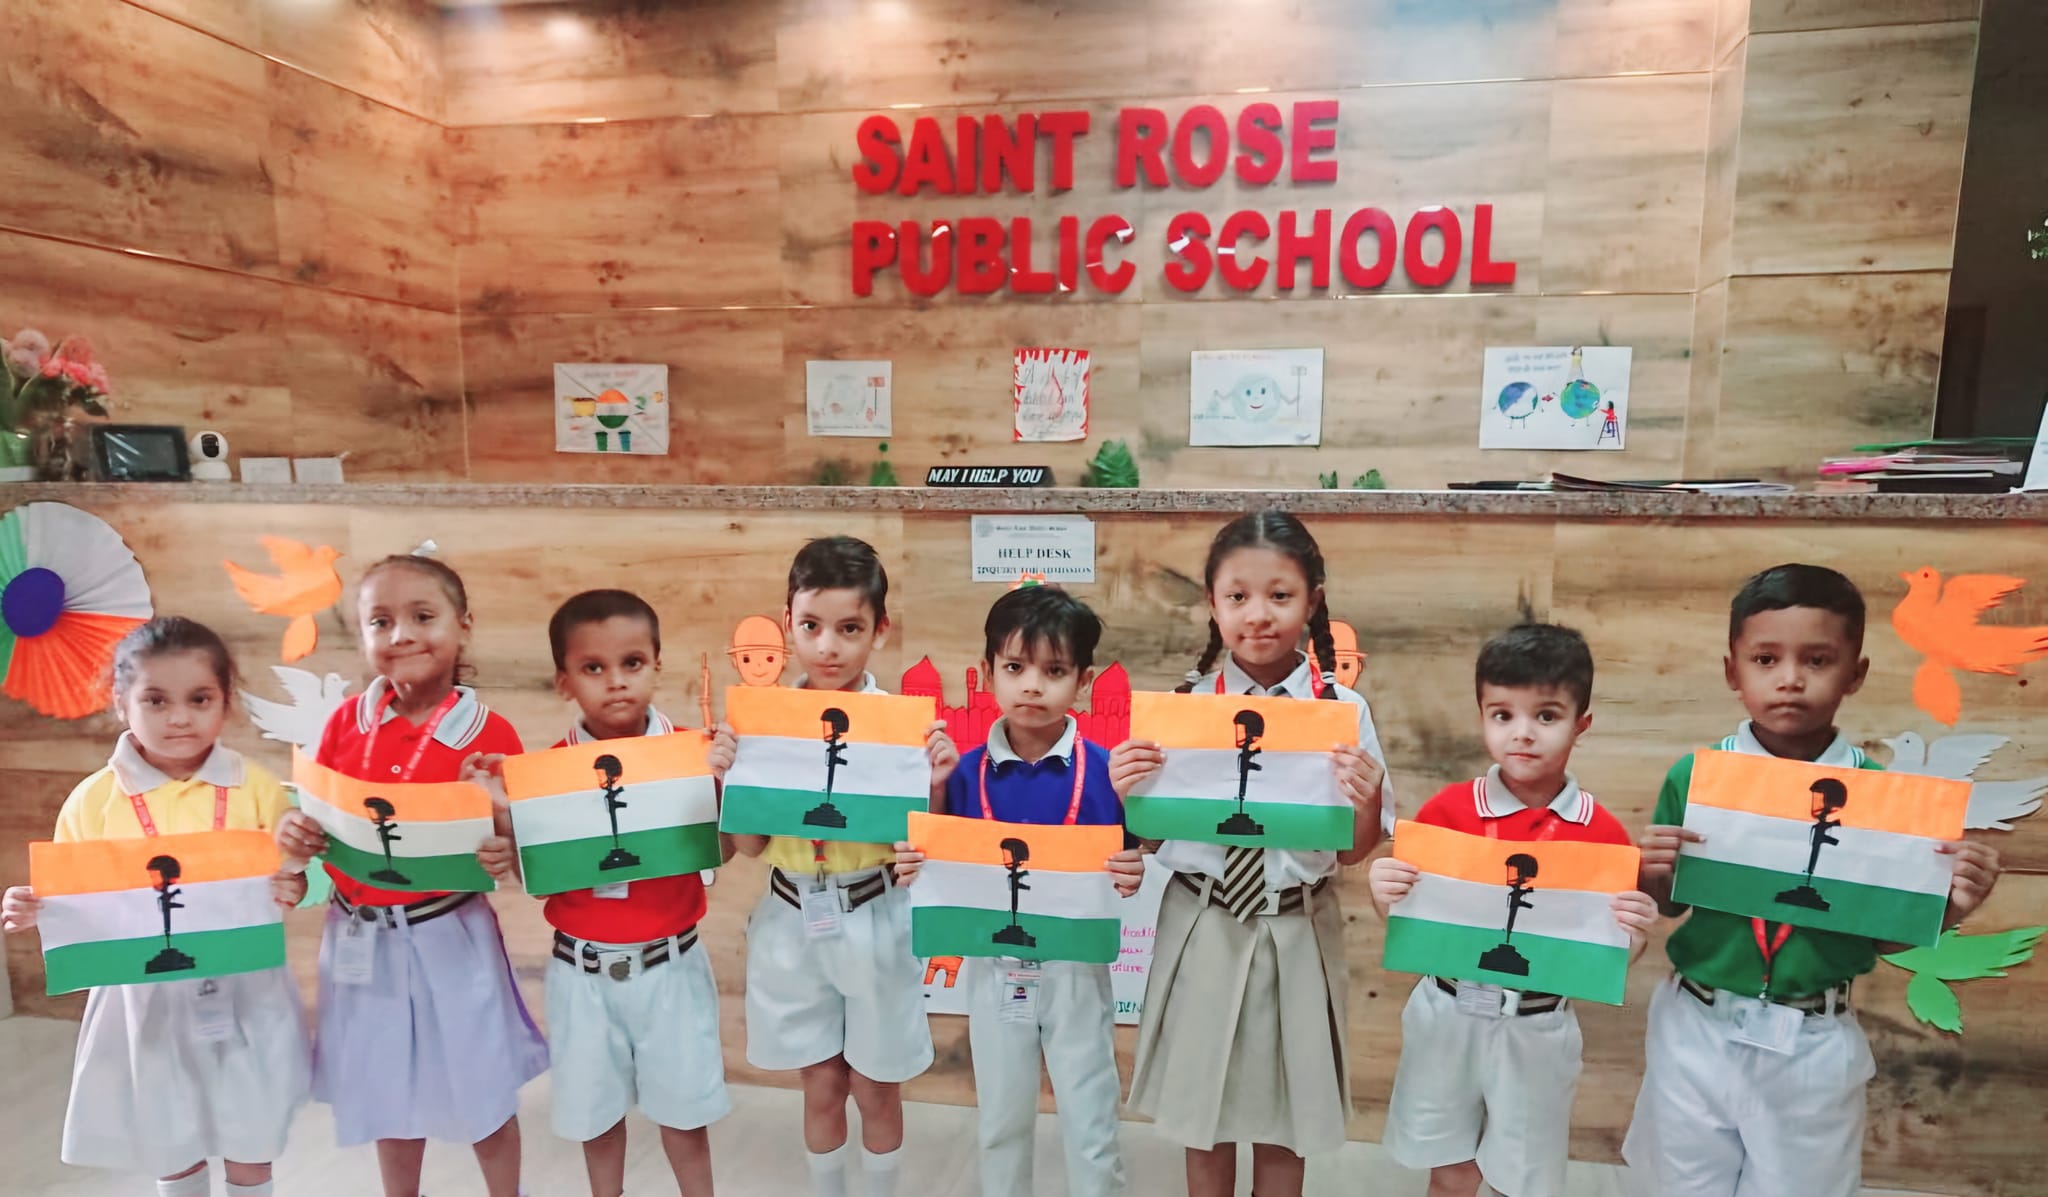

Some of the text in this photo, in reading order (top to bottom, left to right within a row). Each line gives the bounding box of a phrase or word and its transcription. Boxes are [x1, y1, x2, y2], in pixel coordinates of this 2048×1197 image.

[852, 100, 1339, 197] SAINT ROSE
[852, 204, 1517, 297] PUBLIC SCHOOL
[928, 468, 1044, 483] MAY I HELP YOU
[998, 548, 1072, 559] HELP DESK
